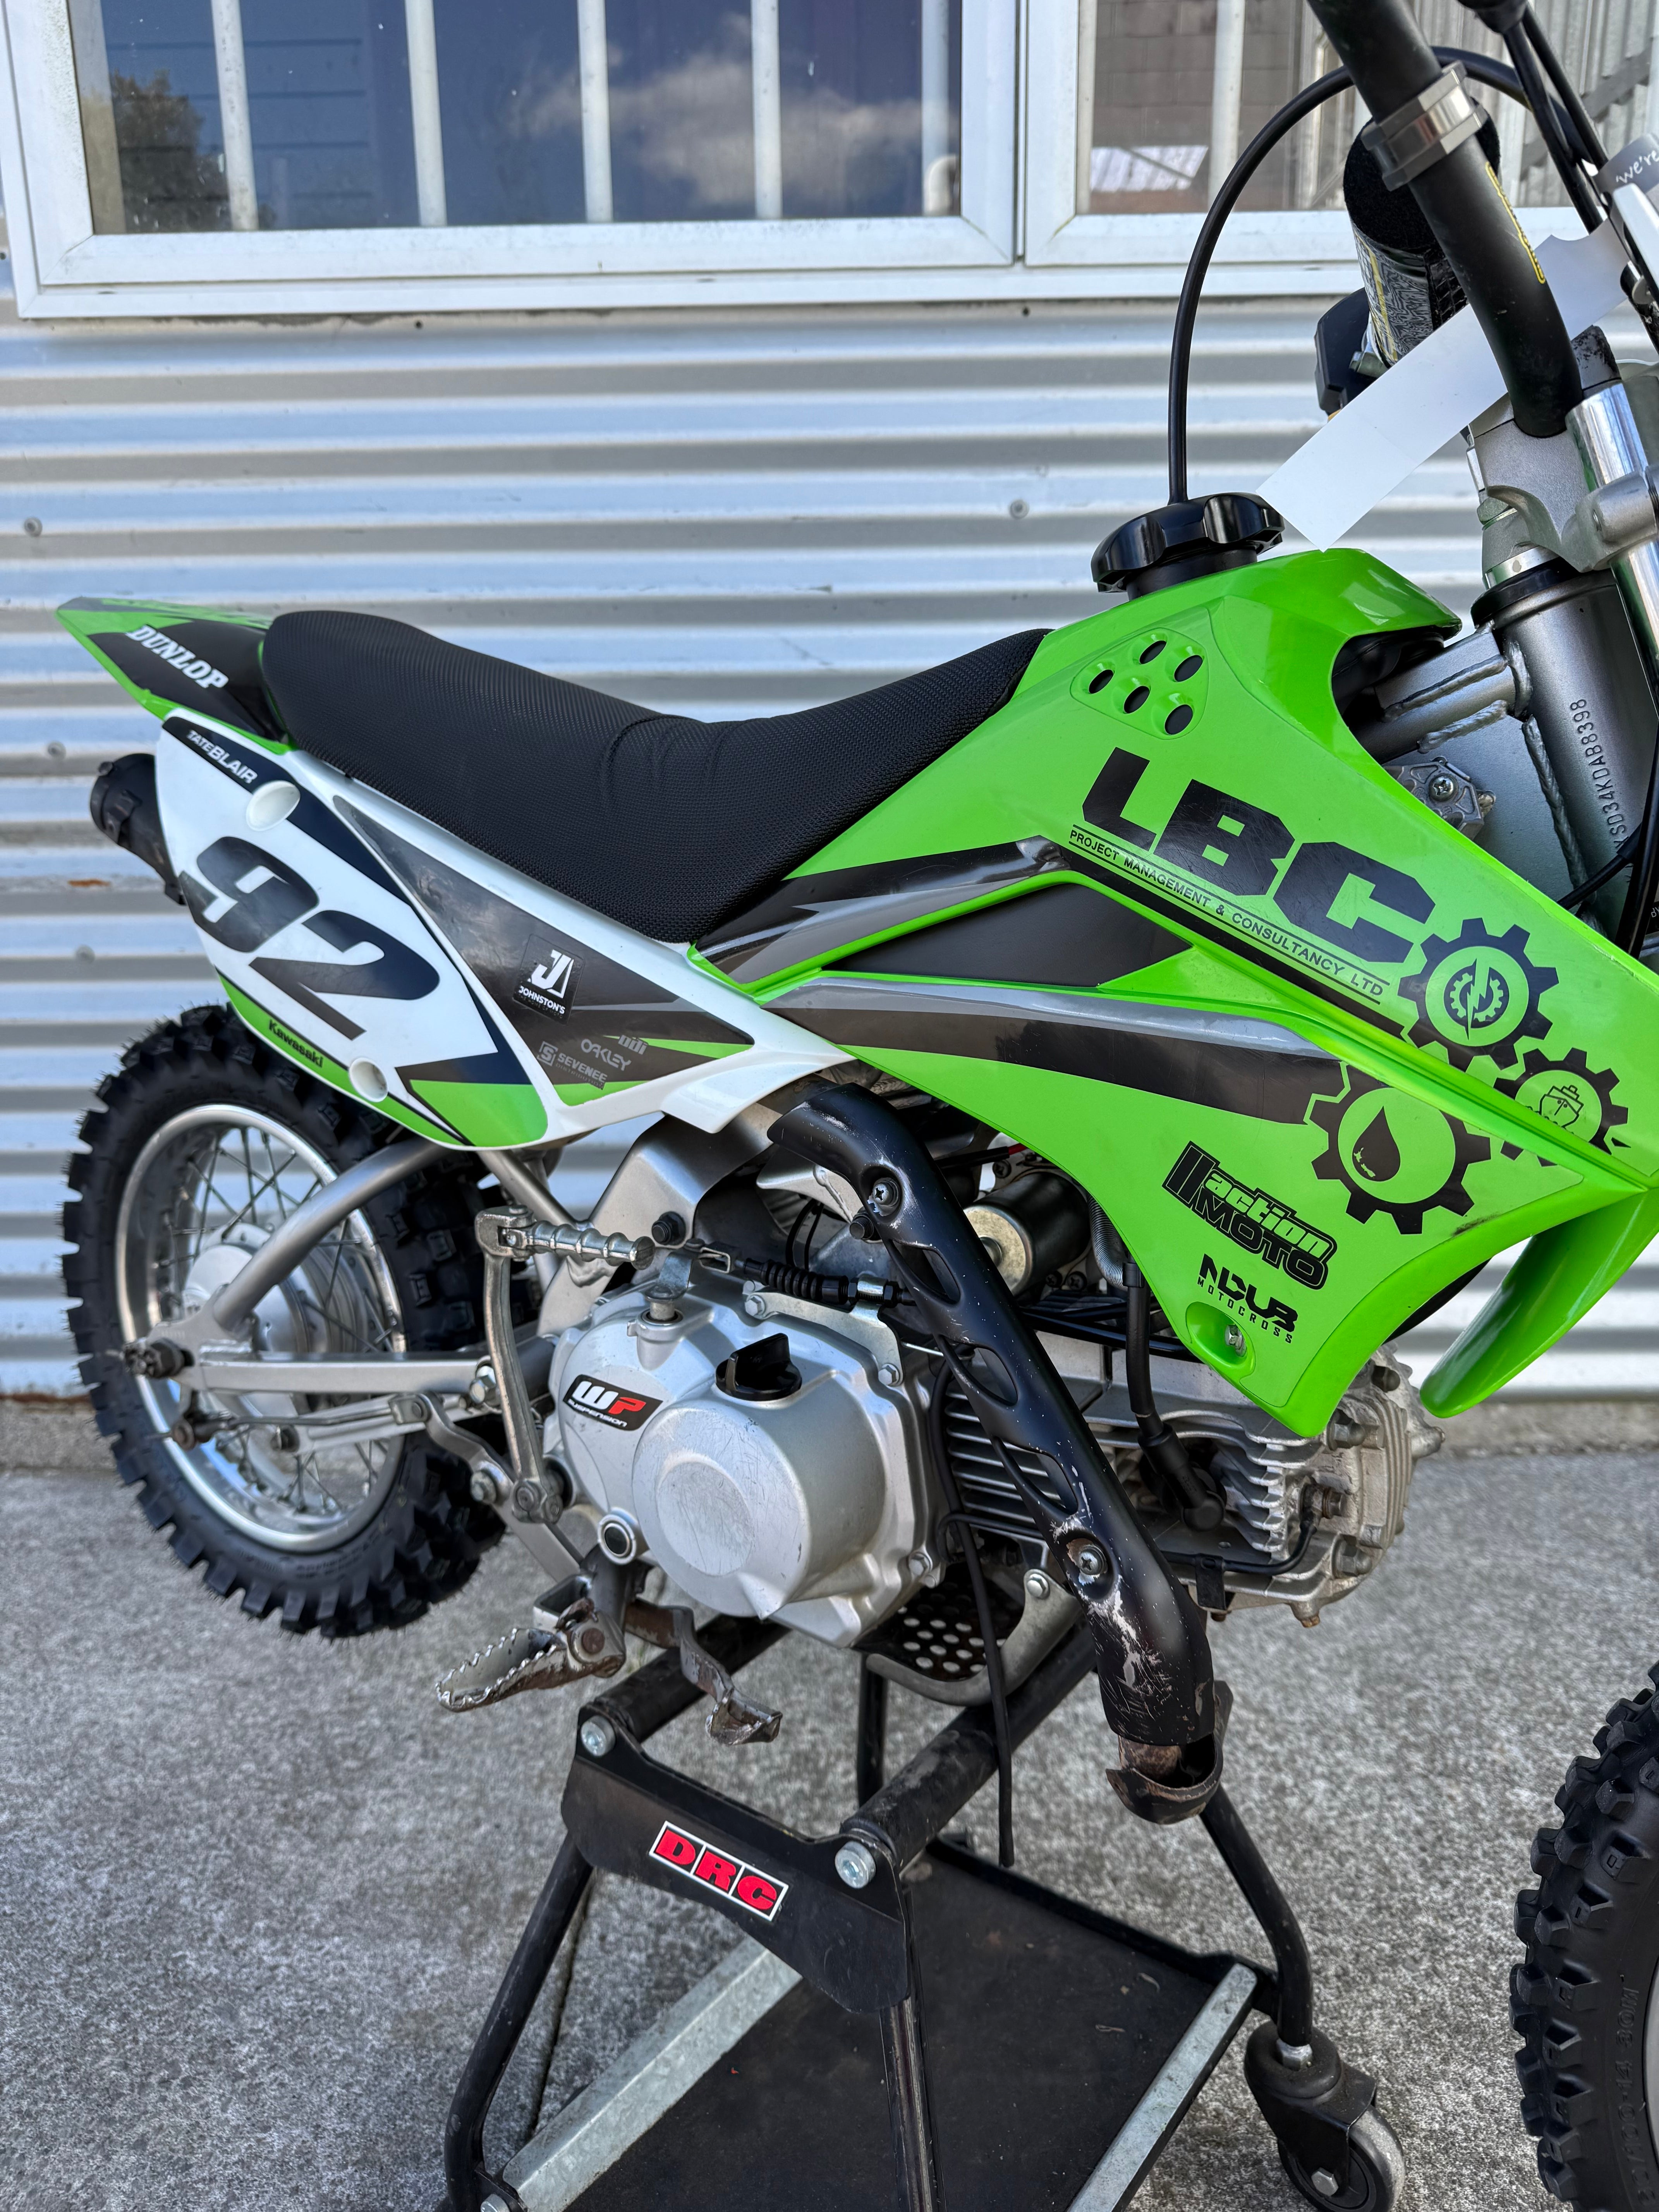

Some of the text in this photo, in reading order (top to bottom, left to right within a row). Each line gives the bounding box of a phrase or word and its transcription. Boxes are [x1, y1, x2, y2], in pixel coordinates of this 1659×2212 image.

[125, 624, 229, 688] DUNLOP
[1082, 747, 1436, 963] LBC
[179, 836, 440, 1041] 92
[1070, 829, 1384, 997] PROJECT MANAGEMENT & CONSULTANCY LTD
[519, 986, 565, 1014] JOHNSTON'S
[269, 1018, 324, 1068] Kawasaki
[558, 1053, 608, 1082] SEVENEE
[581, 1039, 632, 1071] OAKLEY
[1194, 1187, 1325, 1287] MOTO
[1205, 1173, 1330, 1259] action
[1197, 1276, 1293, 1344] MOTOCROSS
[567, 1398, 627, 1427] SUSPENSION
[572, 1381, 646, 1415] WP
[656, 1829, 777, 1910] DRC
